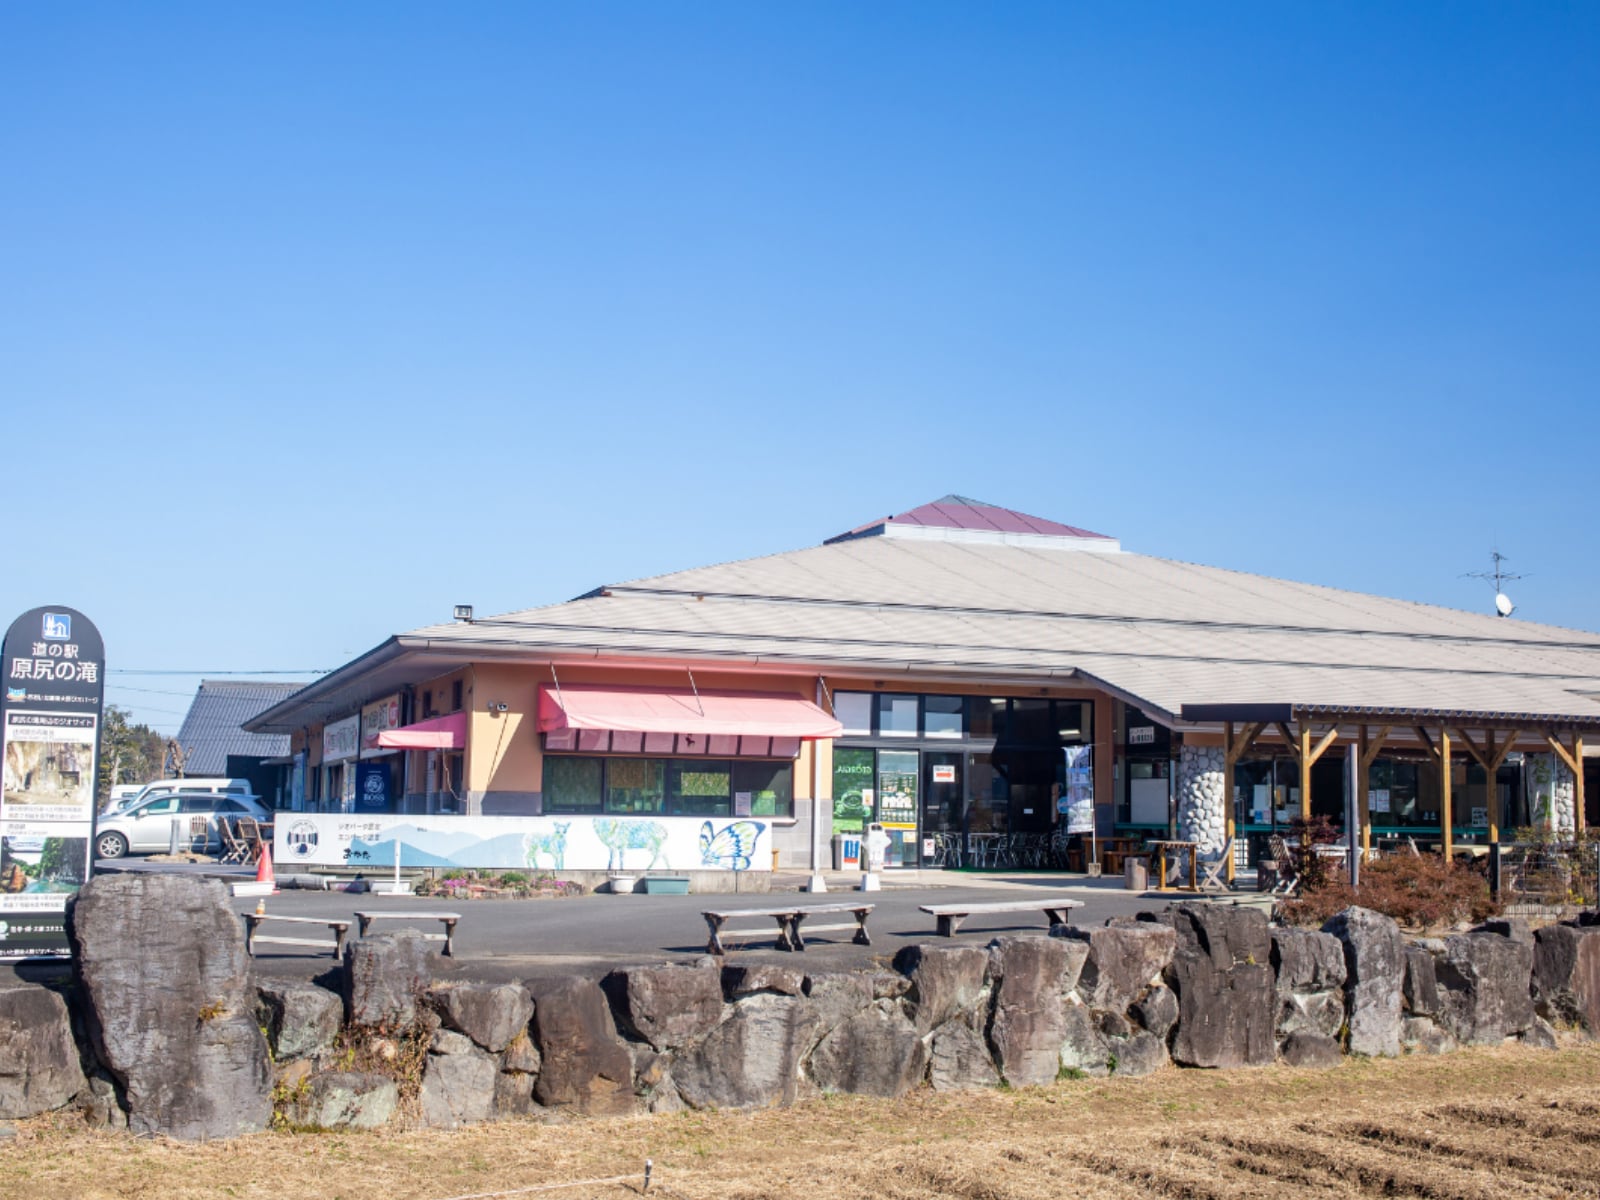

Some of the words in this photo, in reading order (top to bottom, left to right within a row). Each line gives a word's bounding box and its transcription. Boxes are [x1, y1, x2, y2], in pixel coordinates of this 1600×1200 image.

[32, 642, 79, 659] 道の駅
[10, 657, 98, 684] 原尻の滝
